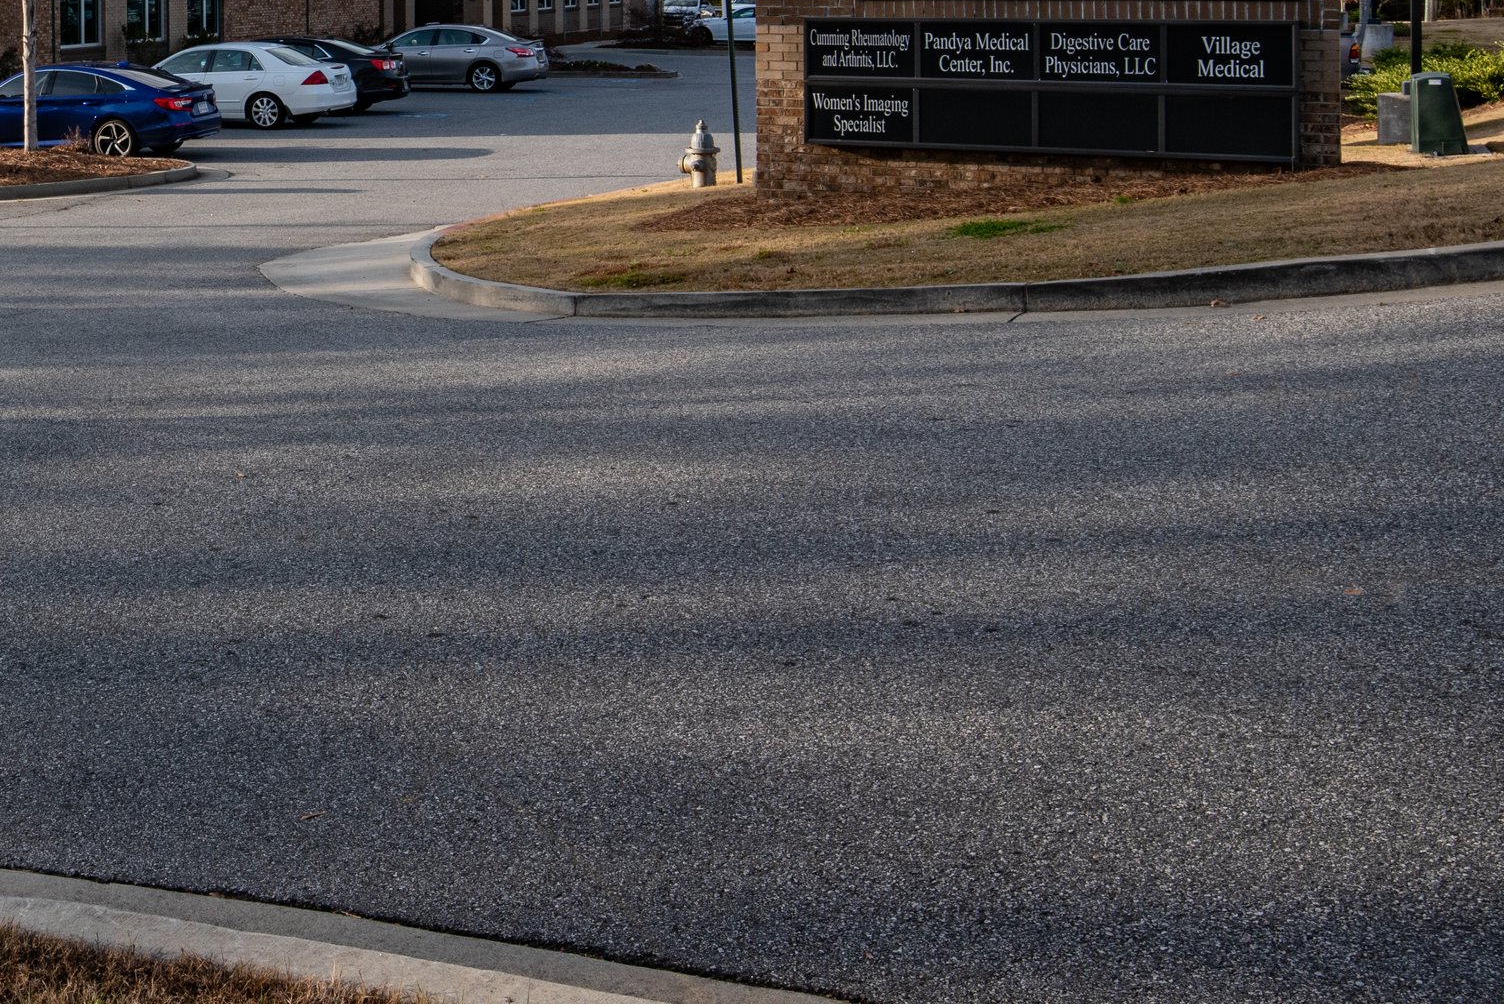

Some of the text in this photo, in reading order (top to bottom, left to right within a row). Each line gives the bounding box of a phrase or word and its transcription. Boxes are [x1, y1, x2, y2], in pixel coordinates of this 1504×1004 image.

[810, 29, 910, 51] Cumming Rheumatology
[924, 32, 1029, 54] Pandya Medical
[1050, 32, 1150, 55] Digestive Care
[1201, 36, 1261, 59] Village
[822, 51, 898, 71] and Arthritis, LLC.
[939, 54, 1014, 76] Center, Inc.
[1045, 56, 1156, 78] Physicians, LLC
[1198, 59, 1265, 78] Medical
[812, 93, 909, 117] Women's Imaging
[834, 114, 886, 136] Specialist
